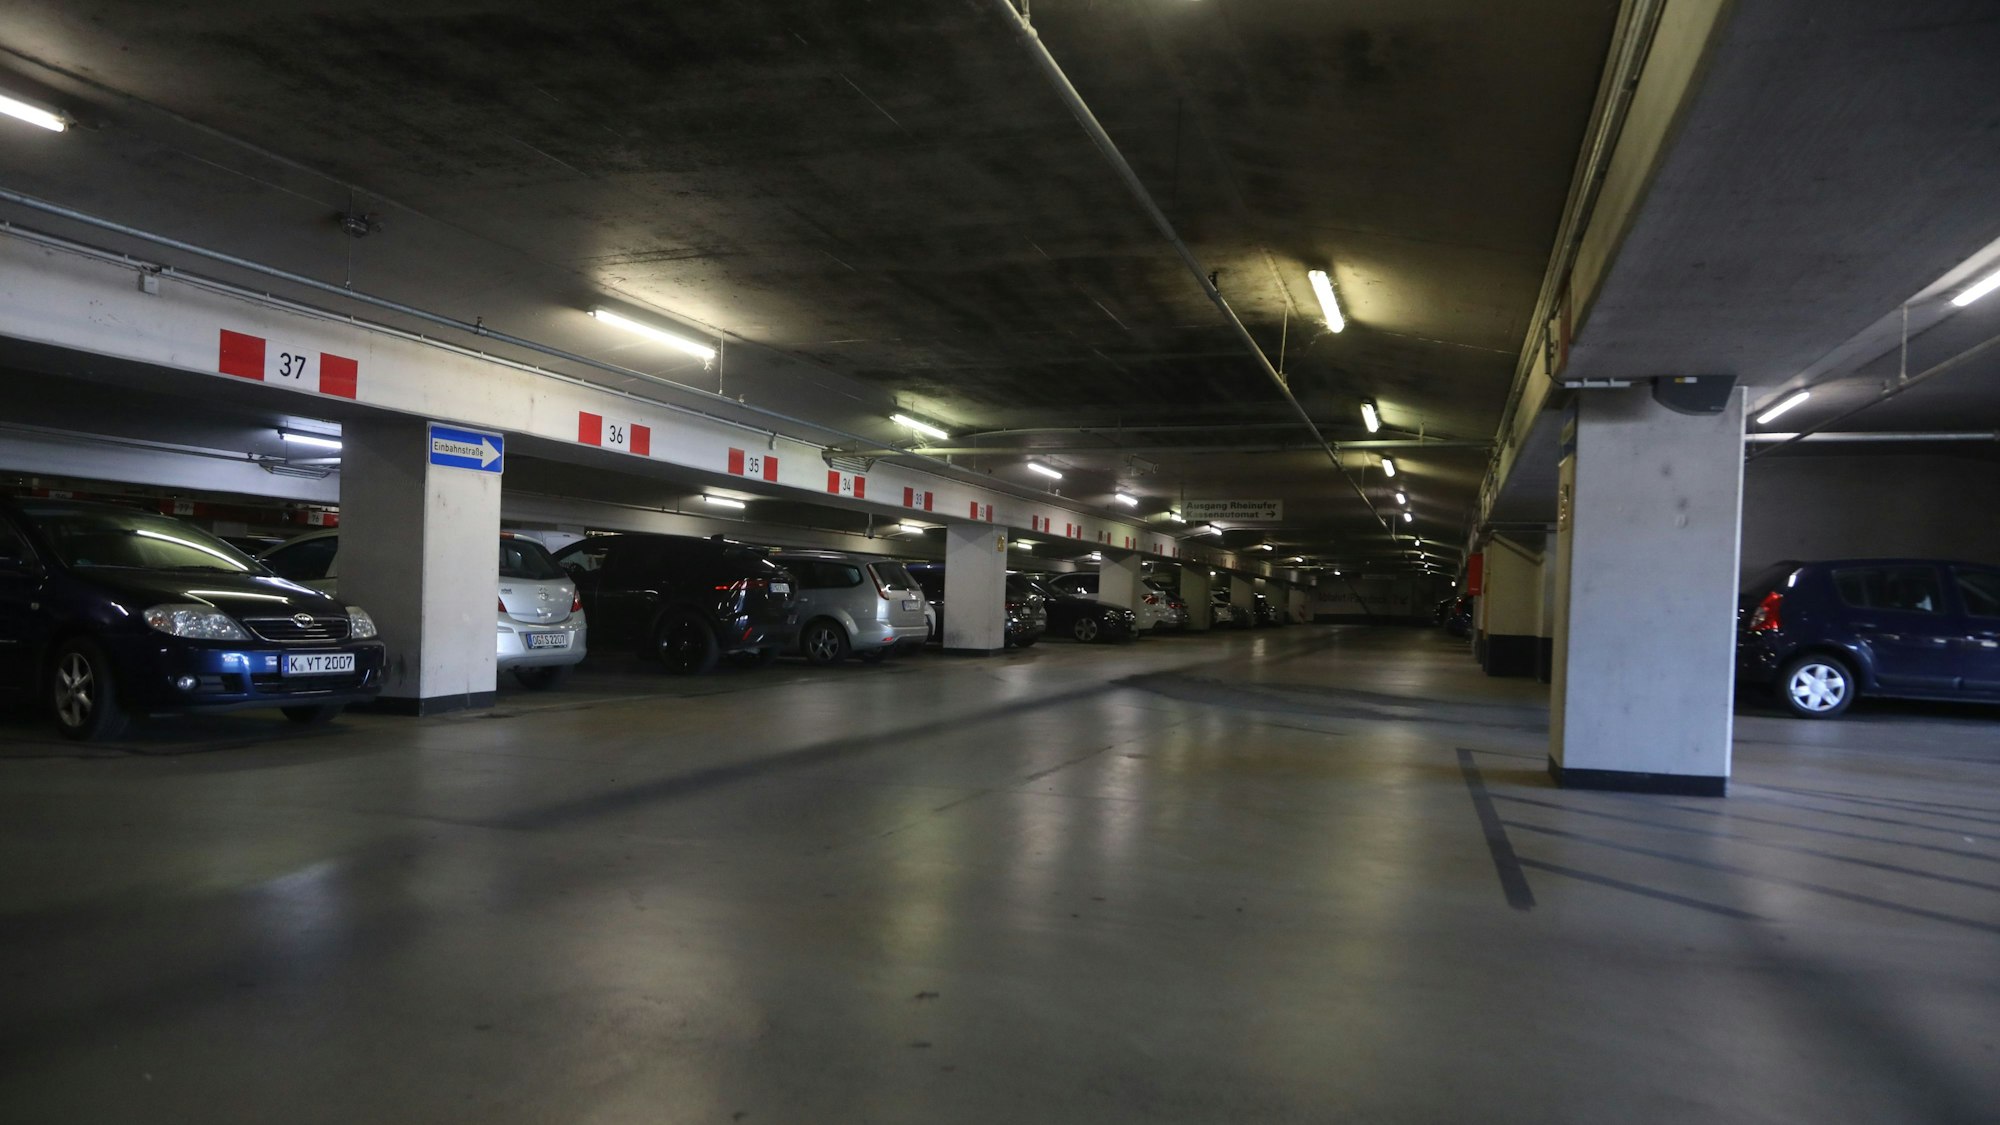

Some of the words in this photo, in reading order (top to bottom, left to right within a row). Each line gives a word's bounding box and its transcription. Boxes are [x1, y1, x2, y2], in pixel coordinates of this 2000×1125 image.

[279, 352, 306, 379] 37
[609, 425, 624, 444] 36
[434, 441, 484, 457] Einbahnstraße
[749, 457, 760, 473] 35
[843, 478, 851, 491] 34
[1186, 502, 1227, 511] Ausgang
[1230, 501, 1277, 510] Rheinufer
[290, 657, 298, 671] K
[307, 656, 321, 671] YT
[325, 655, 353, 670] 2007
